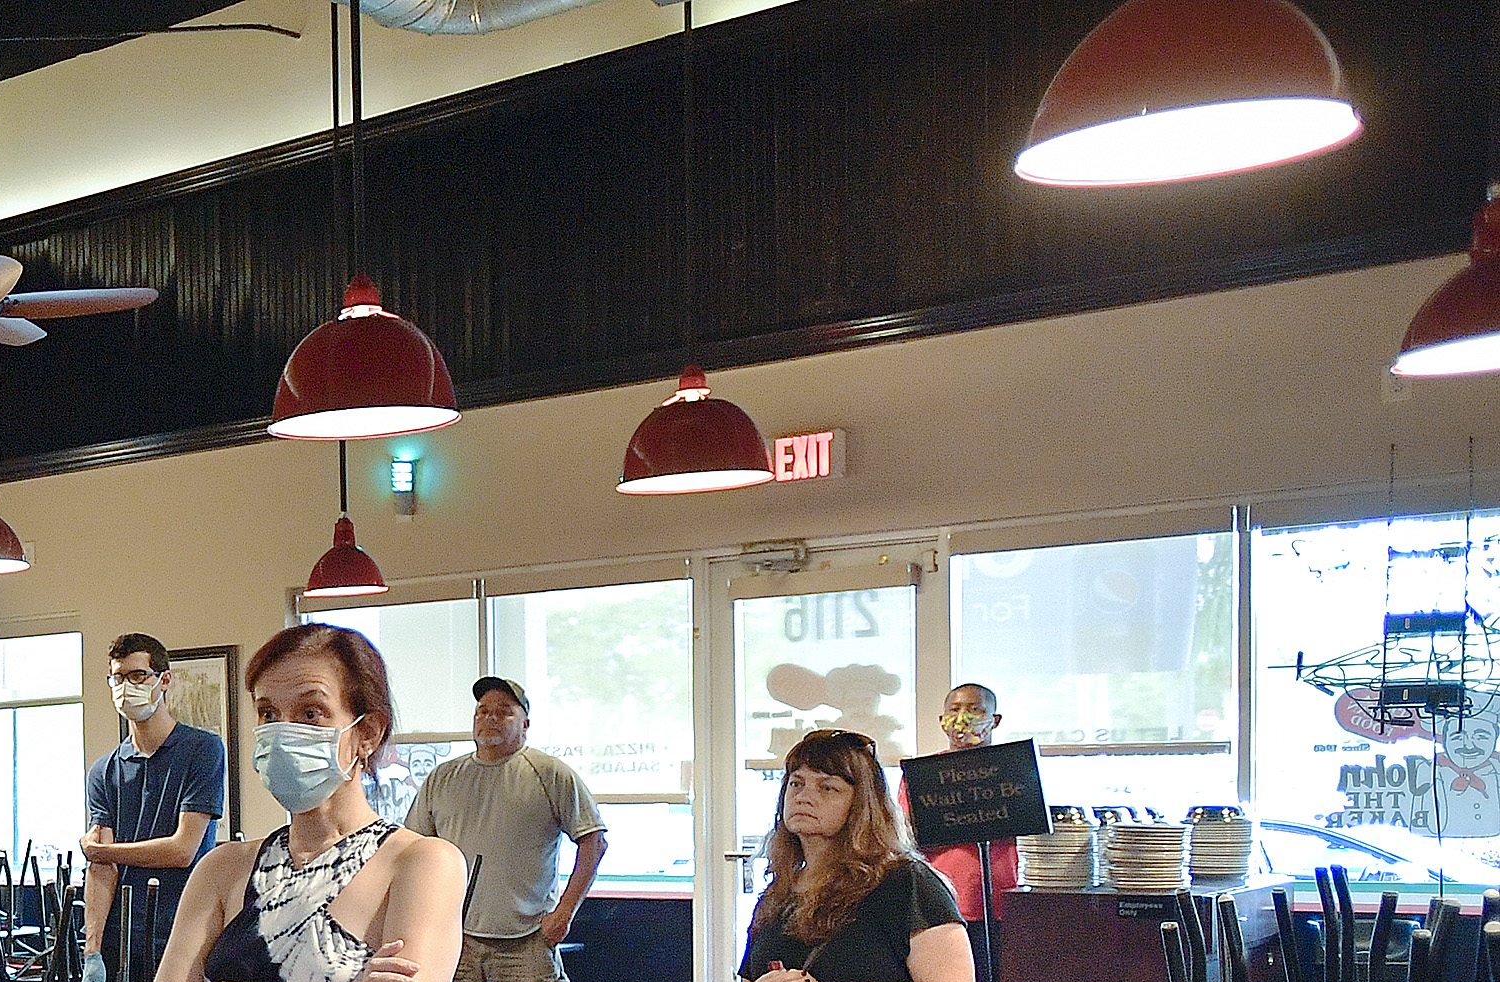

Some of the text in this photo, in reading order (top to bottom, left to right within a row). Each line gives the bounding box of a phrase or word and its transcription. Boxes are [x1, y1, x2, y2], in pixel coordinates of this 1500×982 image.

[775, 432, 834, 481] EXIT
[938, 765, 1000, 785] Please
[919, 782, 1026, 808] Wait To Be
[943, 804, 1010, 826] Seated
